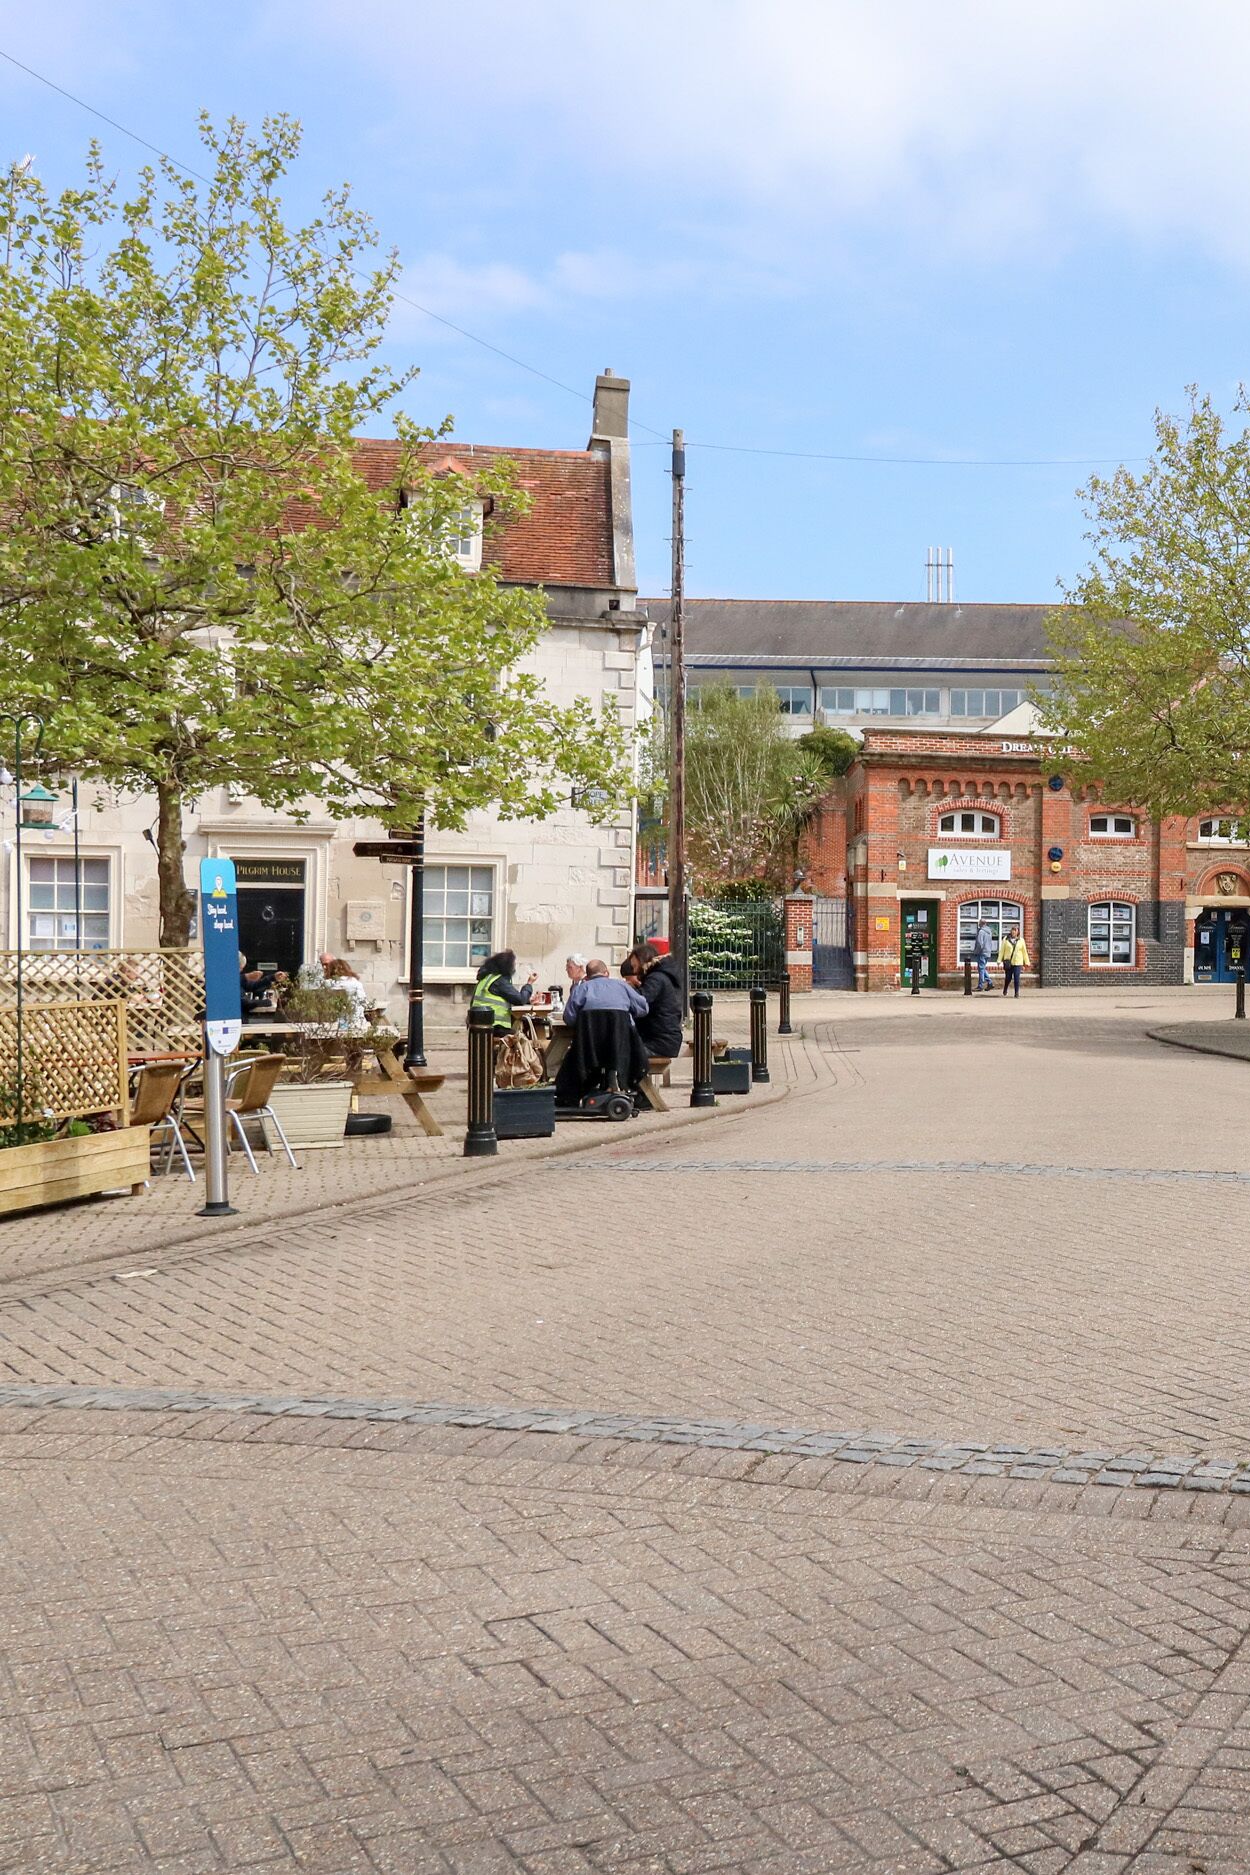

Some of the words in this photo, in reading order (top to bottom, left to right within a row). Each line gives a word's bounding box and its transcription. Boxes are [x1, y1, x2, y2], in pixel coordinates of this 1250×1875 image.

[949, 853, 1003, 866] AVENUE
[237, 865, 268, 876] PILGRIM
[271, 866, 301, 876] HOUSE
